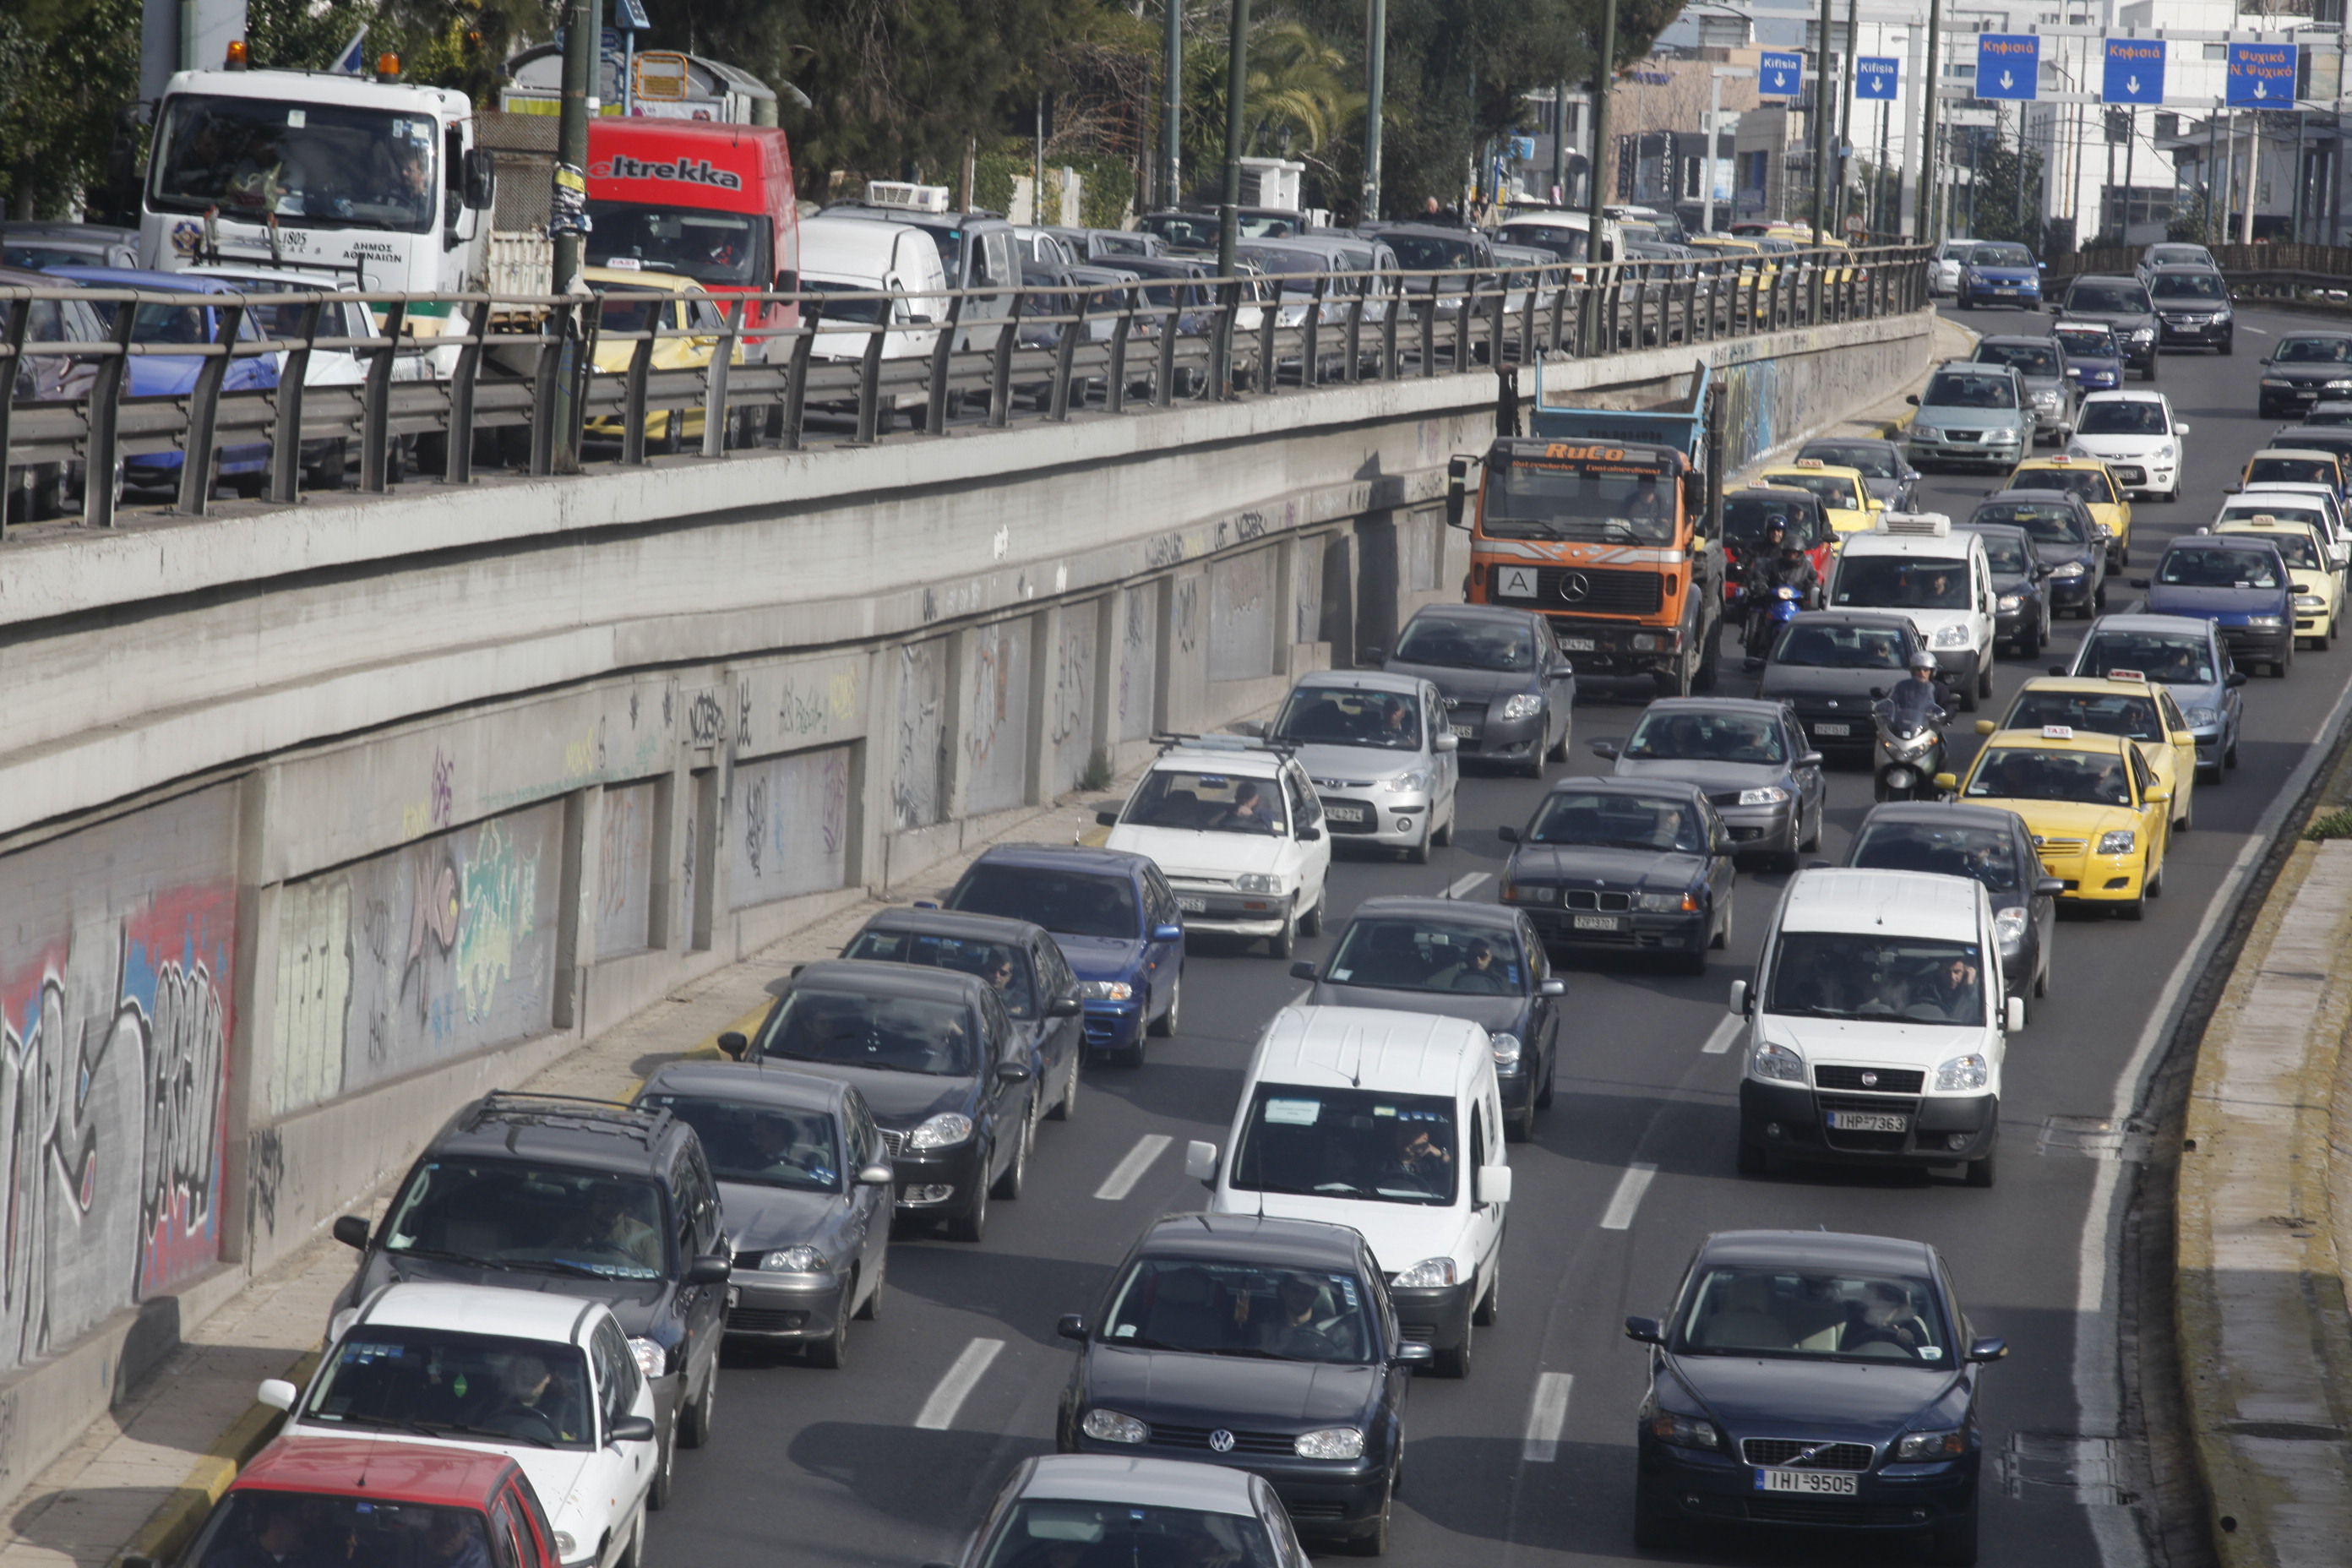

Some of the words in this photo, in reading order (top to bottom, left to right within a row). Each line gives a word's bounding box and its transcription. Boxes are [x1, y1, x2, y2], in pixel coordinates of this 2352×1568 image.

[1983, 41, 2034, 55] Κηφισιά
[2110, 45, 2161, 60] Κηφισιά
[1763, 57, 1797, 70] Kifisia
[2239, 50, 2285, 64] Ψυχικό
[1860, 63, 1894, 74] Kifisia
[2246, 64, 2293, 79] Ψυχικό
[589, 155, 740, 190] eltrekka
[353, 242, 393, 253] ΔΗΜΟΣ
[1544, 443, 1625, 461] RuCo
[1507, 571, 1528, 591] A
[2045, 727, 2070, 735] TAXI
[1772, 1472, 1854, 1493] IHI-9505
